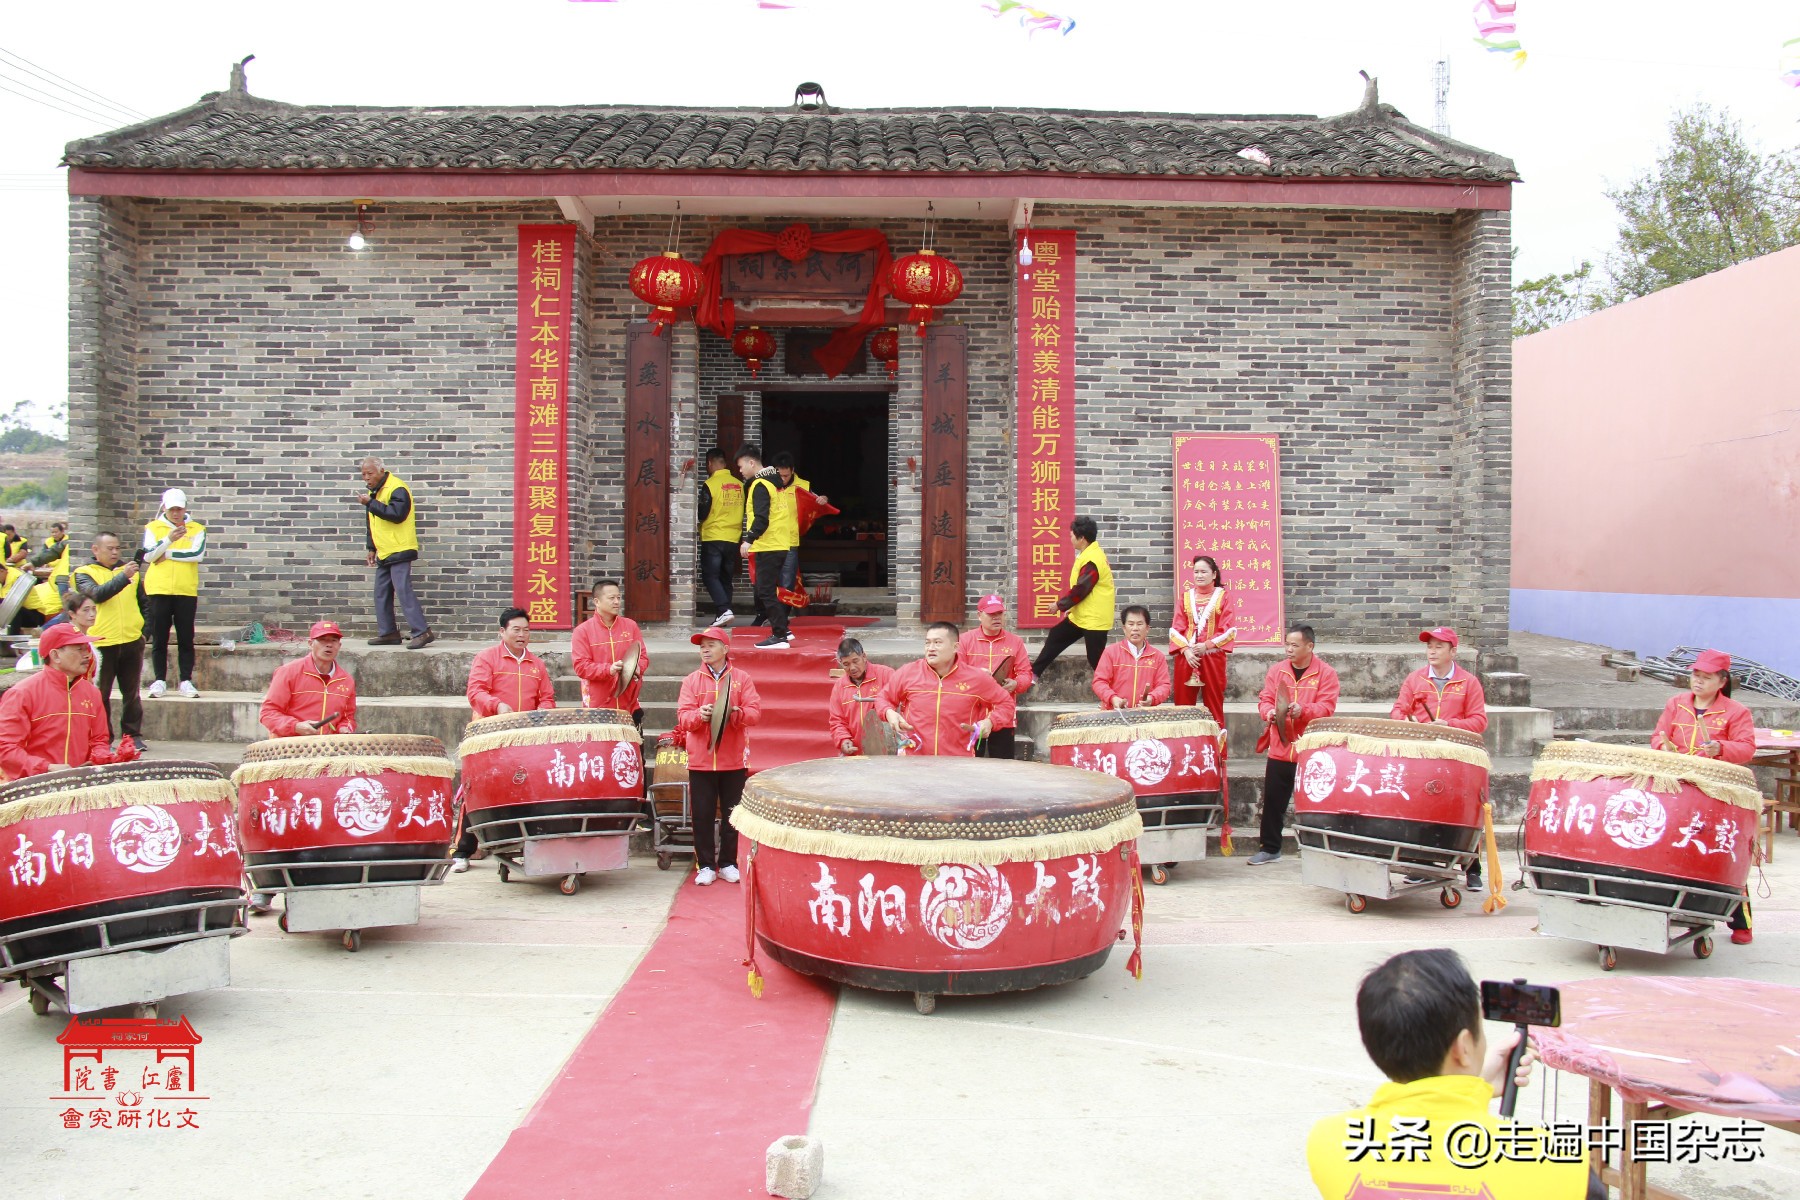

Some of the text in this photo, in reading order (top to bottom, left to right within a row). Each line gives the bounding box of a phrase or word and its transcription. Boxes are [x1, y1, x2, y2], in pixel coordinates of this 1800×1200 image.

[527, 239, 562, 624] 桂祠仁本华南滩三雄聚复地永盛
[1030, 240, 1063, 619] 粤堂贻裕羡清能万狮报兴旺荣昌
[546, 748, 605, 788] 南阳
[1177, 743, 1218, 776] 大鼓
[1342, 758, 1410, 801] 大鼓
[261, 787, 448, 836] 南阳 大鼓
[1539, 787, 1740, 863] 南阳 大鼓
[9, 829, 96, 887] 南阳
[808, 861, 907, 938] 南阳
[1025, 854, 1106, 926] 大鼓
